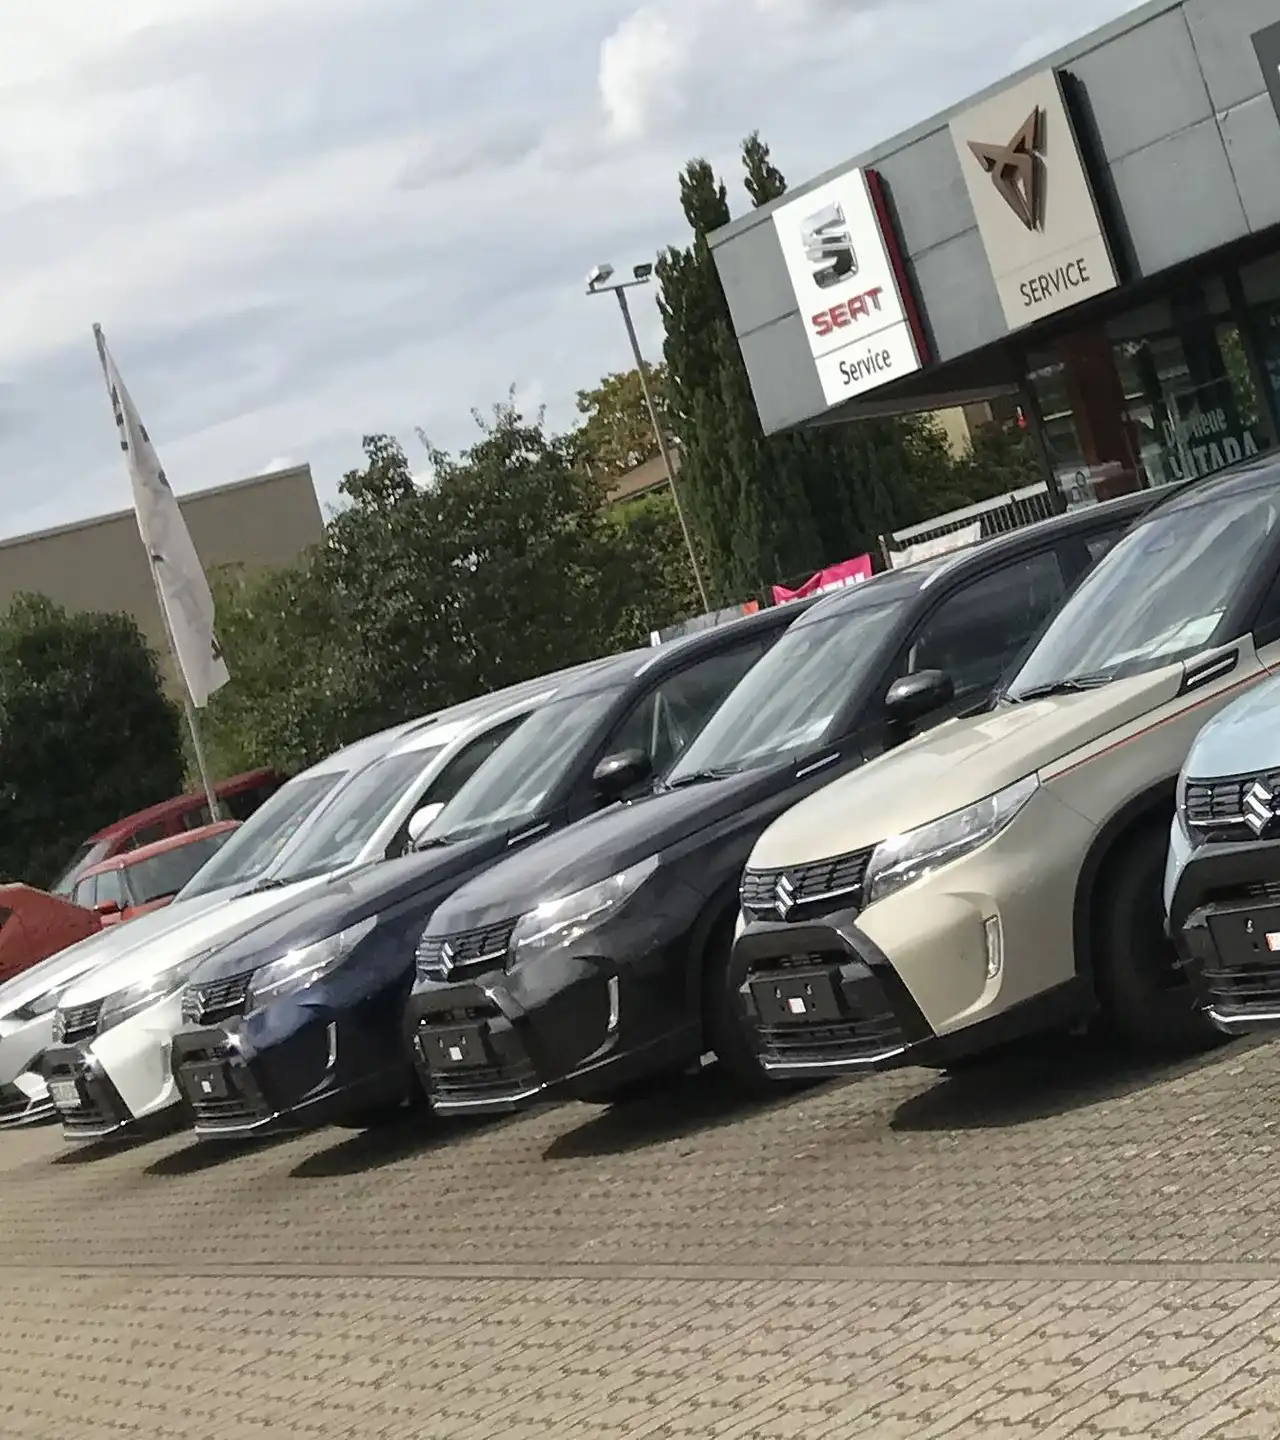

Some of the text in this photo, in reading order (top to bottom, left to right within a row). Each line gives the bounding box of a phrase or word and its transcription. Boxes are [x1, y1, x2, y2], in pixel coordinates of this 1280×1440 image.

[1019, 258, 1091, 307] SERVICE
[811, 287, 883, 337] SEAT
[839, 347, 893, 386] Service
